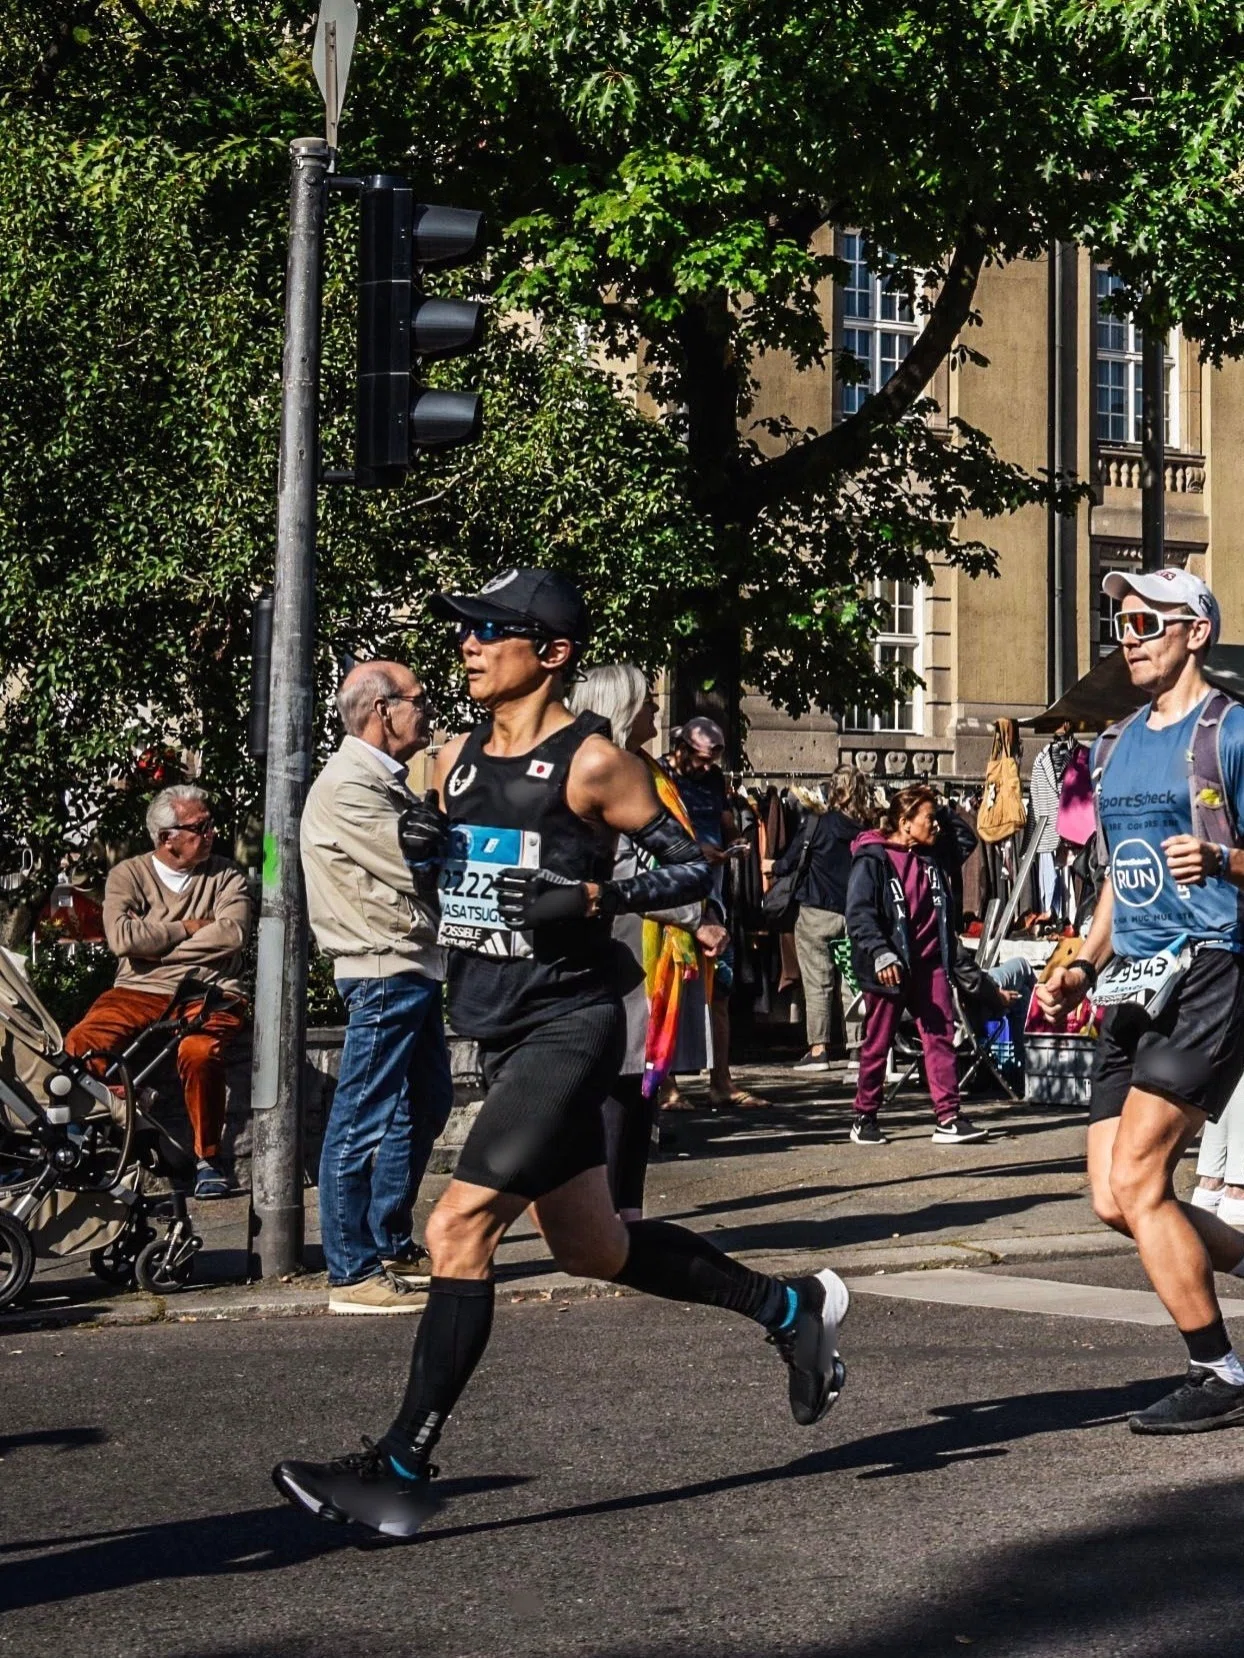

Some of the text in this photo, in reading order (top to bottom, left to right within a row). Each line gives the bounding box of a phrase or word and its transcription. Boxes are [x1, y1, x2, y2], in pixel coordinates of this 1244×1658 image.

[1116, 868, 1157, 890] RUN
[441, 903, 507, 924] ASATSUG
[443, 924, 482, 940] OSSIBLE
